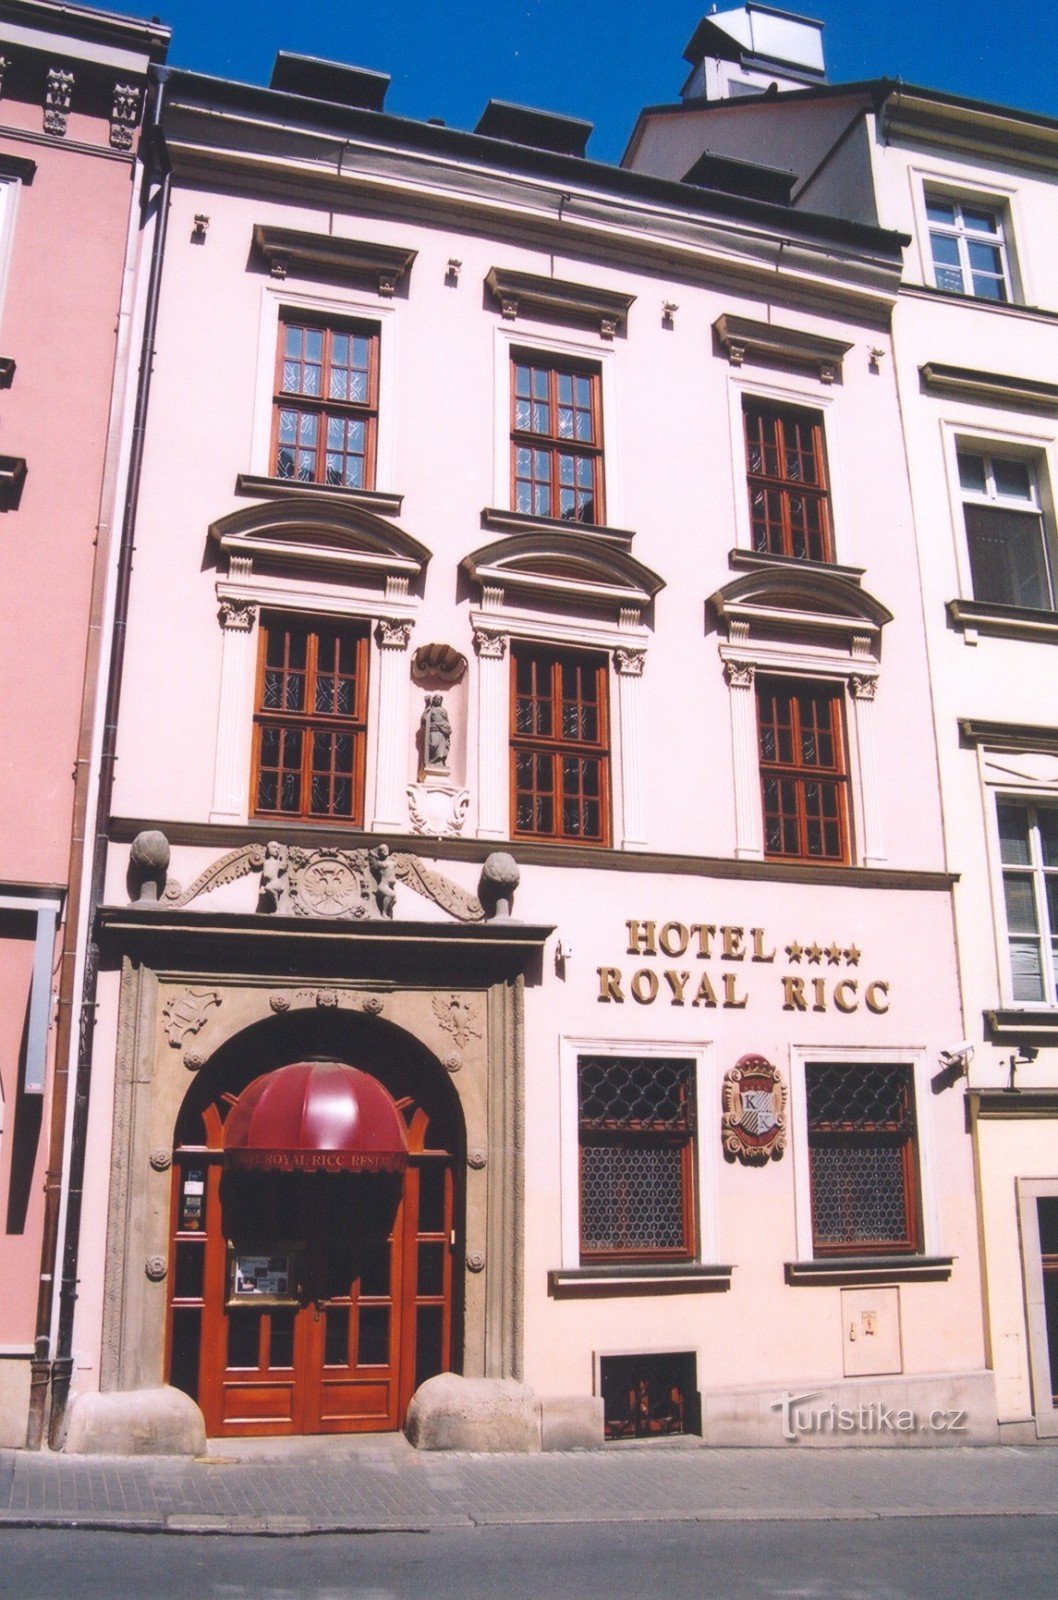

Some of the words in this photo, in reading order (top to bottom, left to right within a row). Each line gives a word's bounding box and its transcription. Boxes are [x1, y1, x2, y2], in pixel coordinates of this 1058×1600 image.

[625, 920, 777, 964] HOTEL
[597, 966, 749, 1009] ROYAL
[781, 976, 890, 1015] RICC
[745, 1094, 757, 1110] K
[265, 1154, 309, 1167] ROYAL
[312, 1155, 344, 1167] RICC
